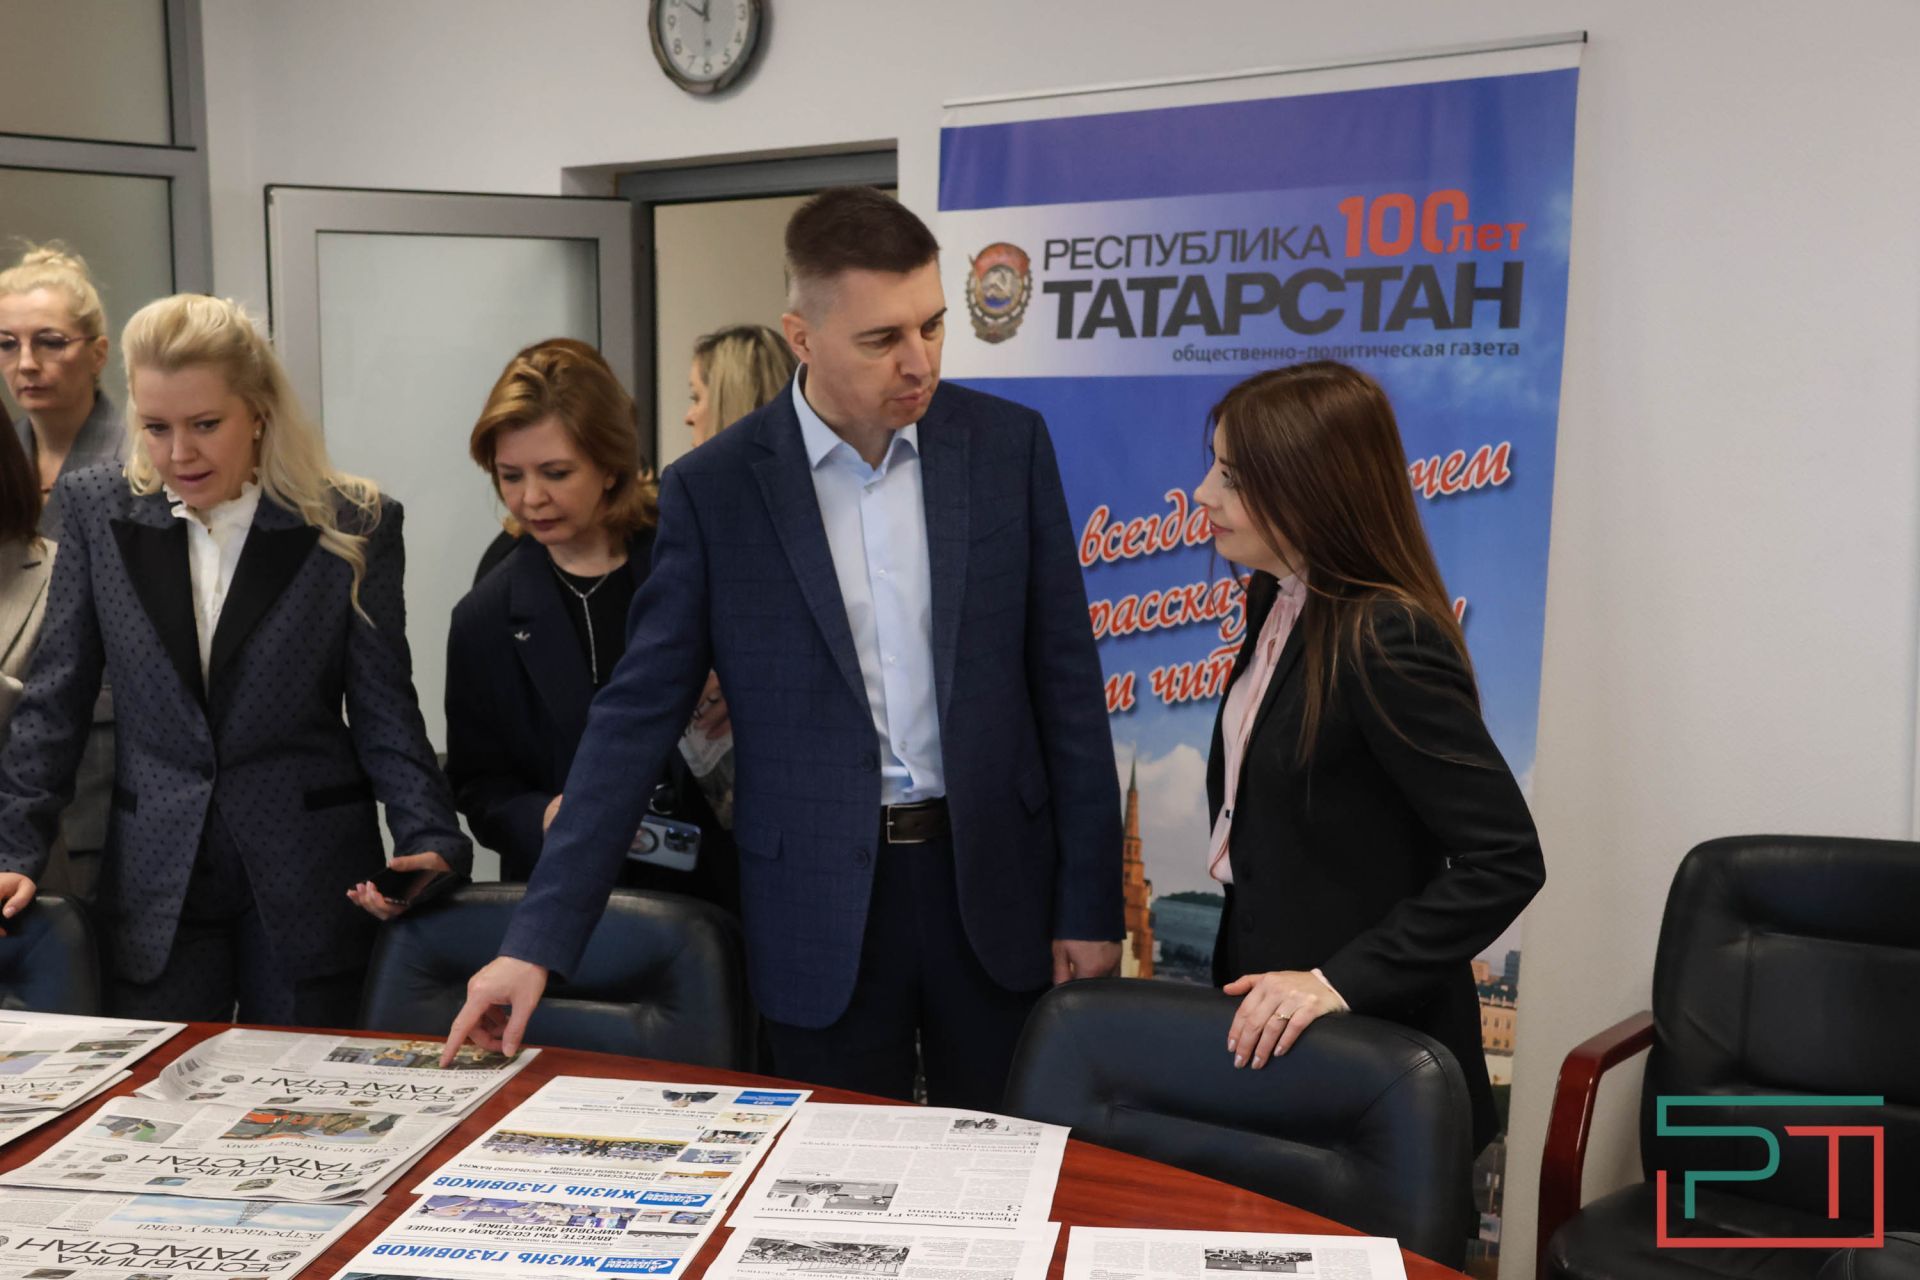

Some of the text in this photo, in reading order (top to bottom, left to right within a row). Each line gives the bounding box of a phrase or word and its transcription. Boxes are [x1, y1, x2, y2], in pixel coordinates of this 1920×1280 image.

[668, 15, 676, 31] 9
[674, 38, 682, 55] 8
[1044, 224, 1332, 271] РЕСПУБЛИКА
[1043, 261, 1524, 341] ТАТАРСТАН
[1173, 341, 1520, 363] общественно-политическая газета
[1080, 488, 1212, 567] всегда
[251, 1077, 447, 1095] ТАТАРСТАН
[134, 1155, 353, 1172] ТАТАРСТАН
[432, 1177, 641, 1199] ЖИЗНЬ ГАЗОВИКОВ
[468, 1228, 531, 1237] СОЗДАЕМ
[561, 1227, 623, 1235] МИРОВОЙ
[14, 1238, 260, 1262] ТАТАРСТАН
[372, 1244, 602, 1267] ЖИЗНЬ ГАЗОВИКОВ
[57, 1254, 291, 1273] РЕСПУБЛИКА
